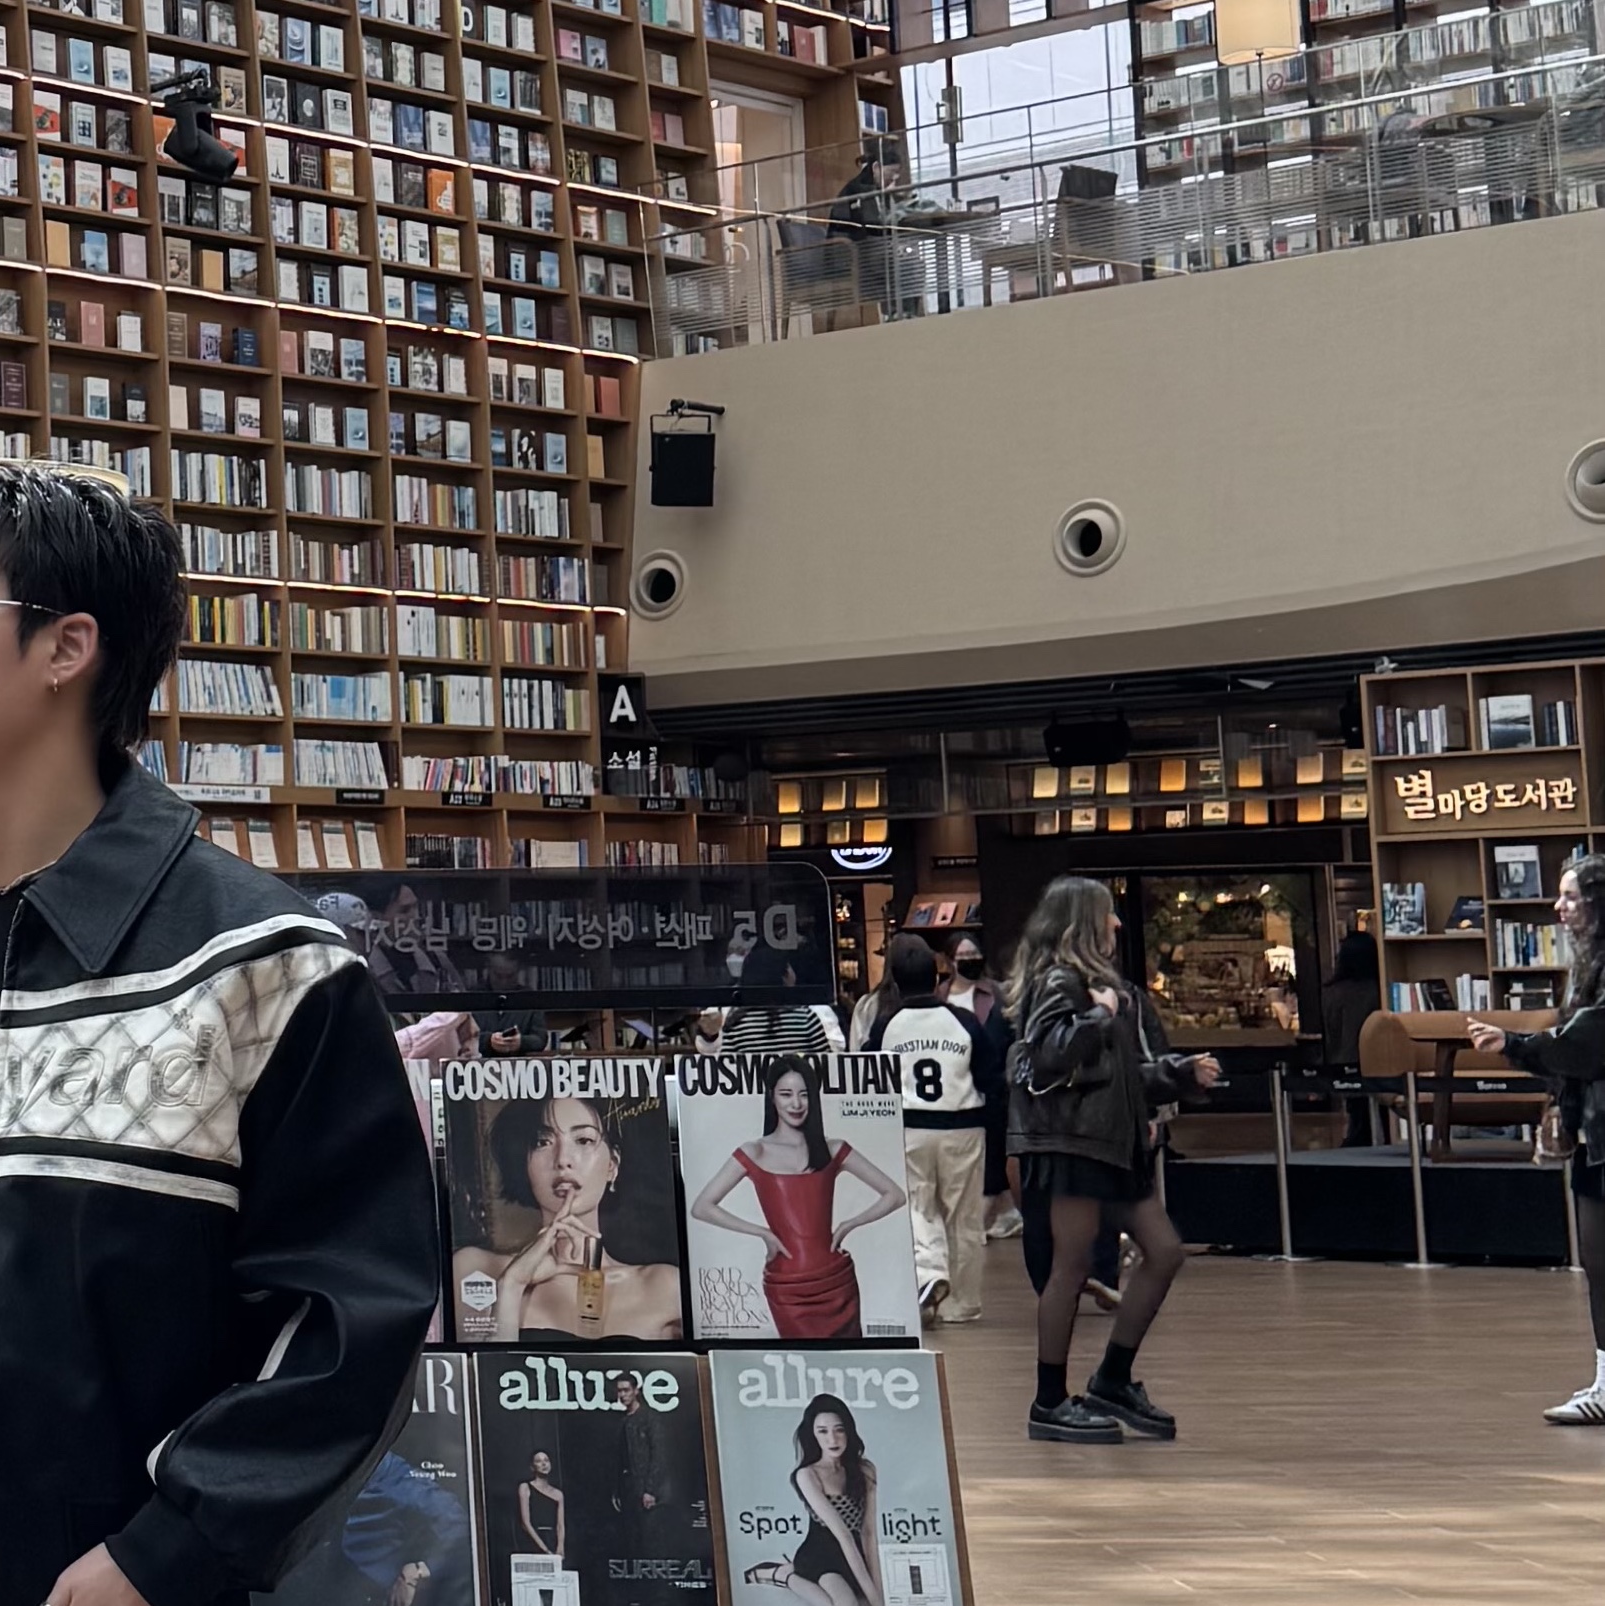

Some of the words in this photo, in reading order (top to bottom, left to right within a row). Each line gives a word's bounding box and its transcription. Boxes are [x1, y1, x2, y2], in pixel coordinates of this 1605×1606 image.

[609, 684, 637, 723] A
[606, 749, 641, 770] 소설
[1395, 769, 1491, 821] 별마당
[1493, 777, 1577, 811] 도서관
[446, 1058, 548, 1100] COSMO
[551, 1057, 662, 1099] BEAUTY
[913, 1058, 943, 1103] 8
[498, 1355, 680, 1412] allure
[737, 1353, 921, 1410] allure
[739, 1510, 803, 1540] Spot
[882, 1511, 943, 1544] light
